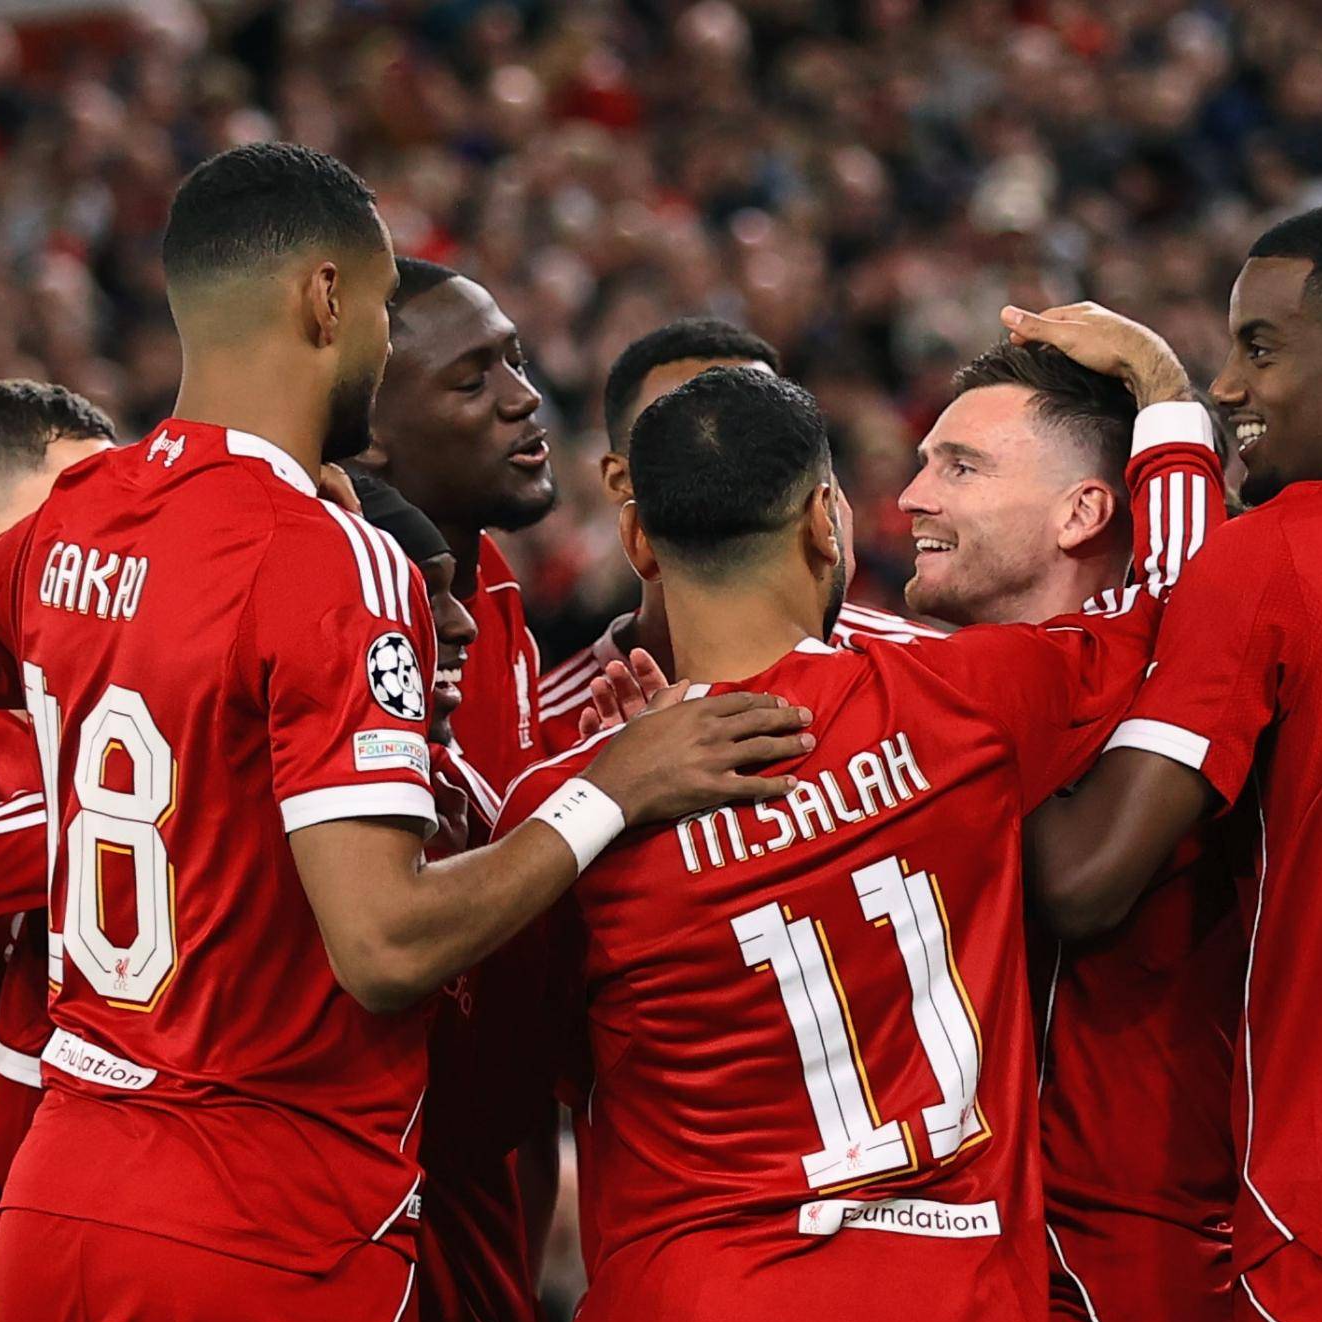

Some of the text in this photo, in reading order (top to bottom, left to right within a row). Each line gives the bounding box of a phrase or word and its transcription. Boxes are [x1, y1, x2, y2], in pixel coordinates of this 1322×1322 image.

[22, 660, 178, 1013] 18
[676, 731, 932, 874] M.SALAH
[730, 855, 993, 1196] 11
